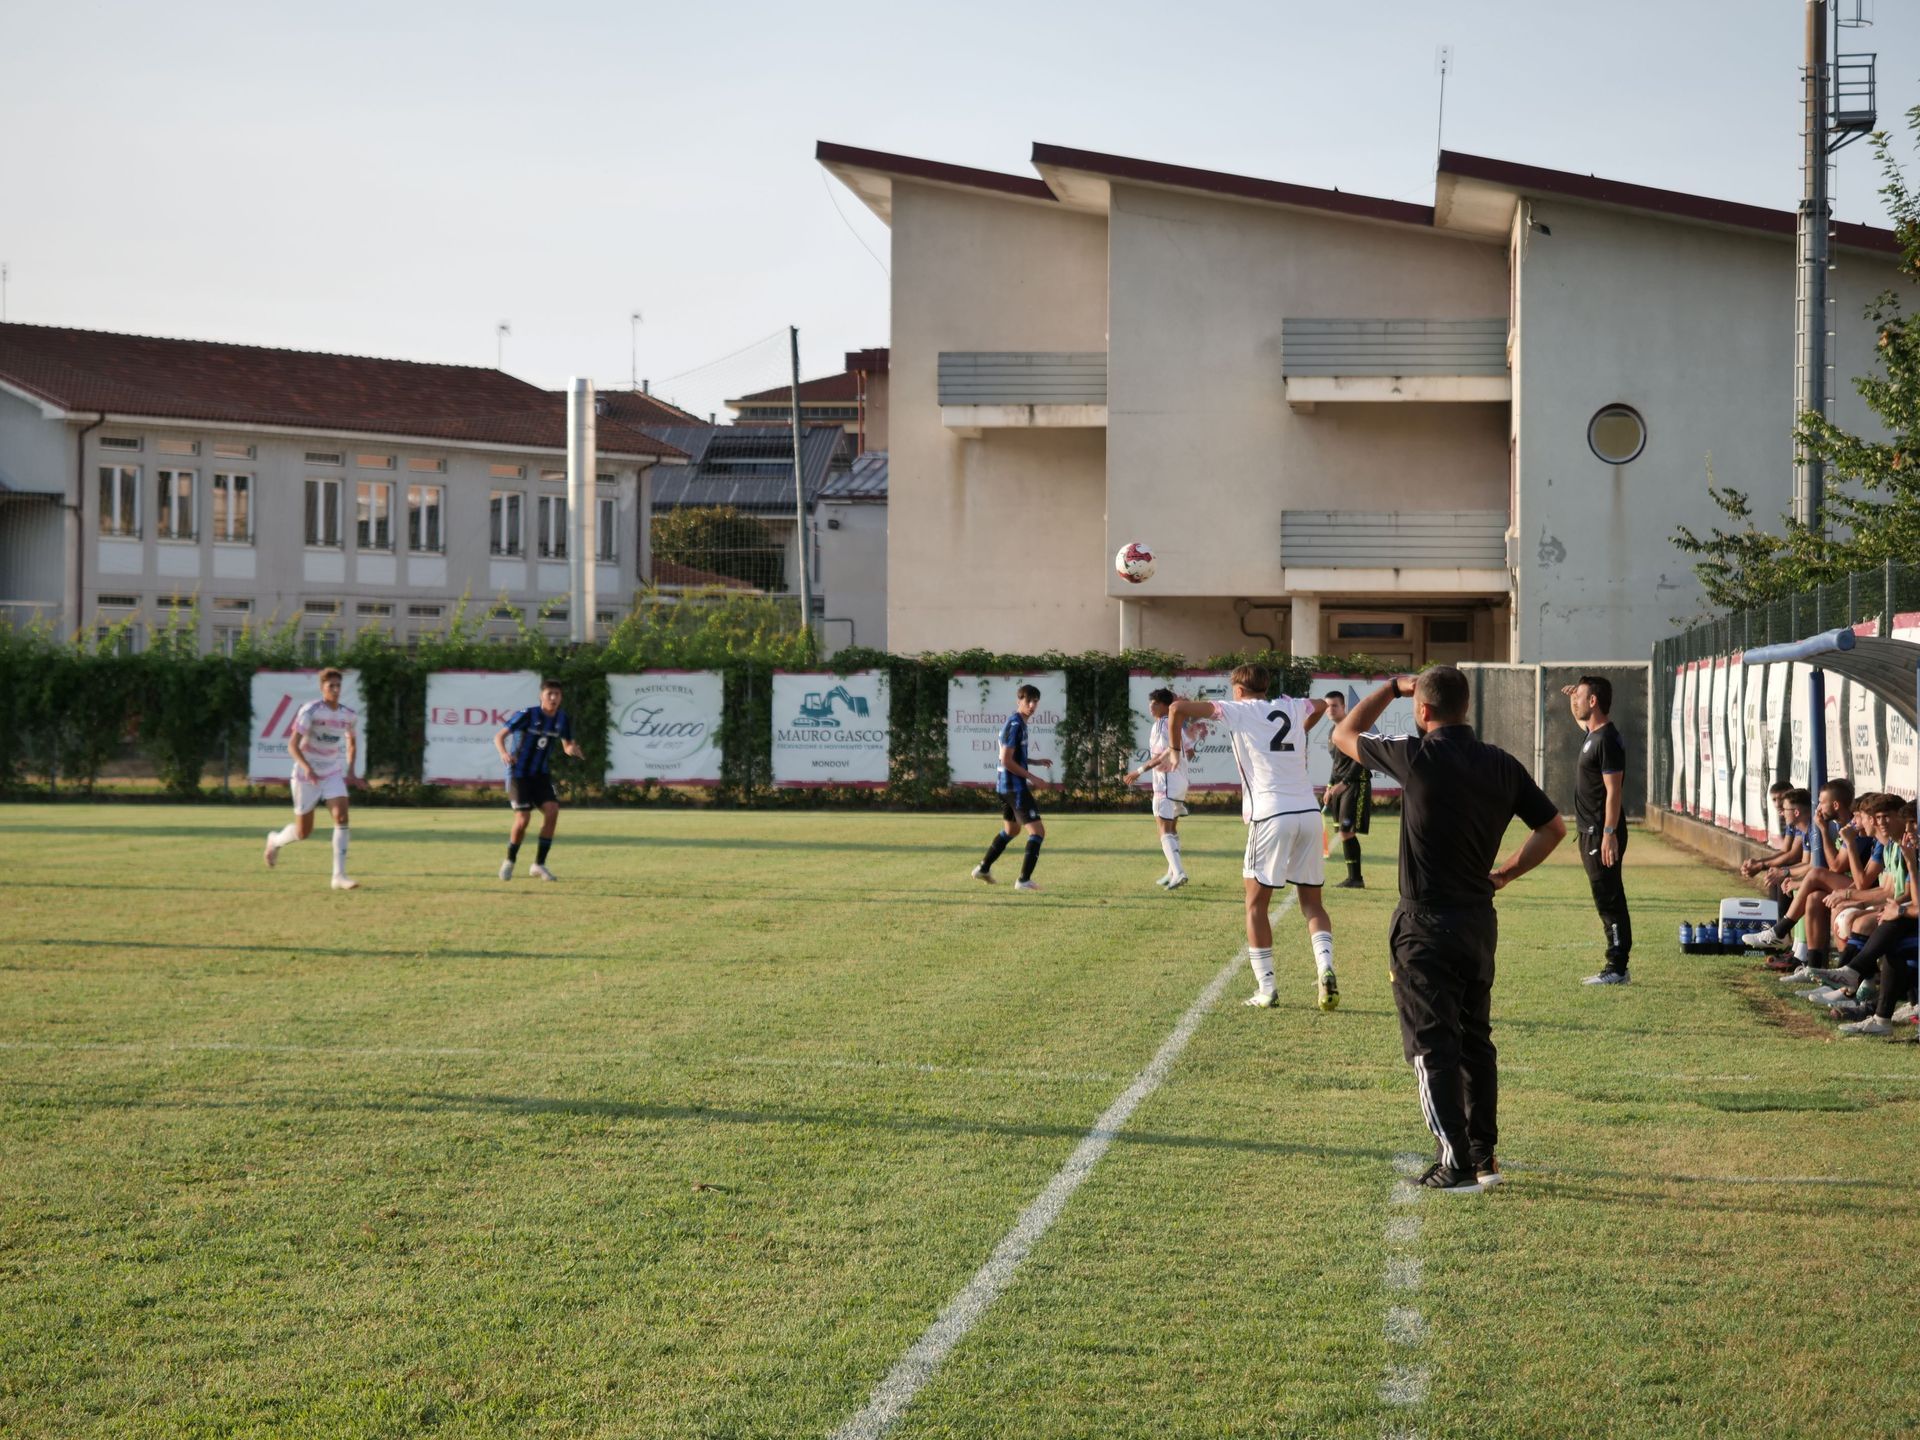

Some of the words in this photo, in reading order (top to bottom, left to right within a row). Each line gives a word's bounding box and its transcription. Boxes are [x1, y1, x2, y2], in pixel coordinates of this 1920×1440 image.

[634, 685, 694, 696] PASTICCERIA
[623, 707, 705, 738] Zucco
[956, 710, 1006, 725] Fontana
[777, 730, 831, 742] MAURO
[834, 730, 884, 742] GASCO
[1266, 710, 1295, 751] 2
